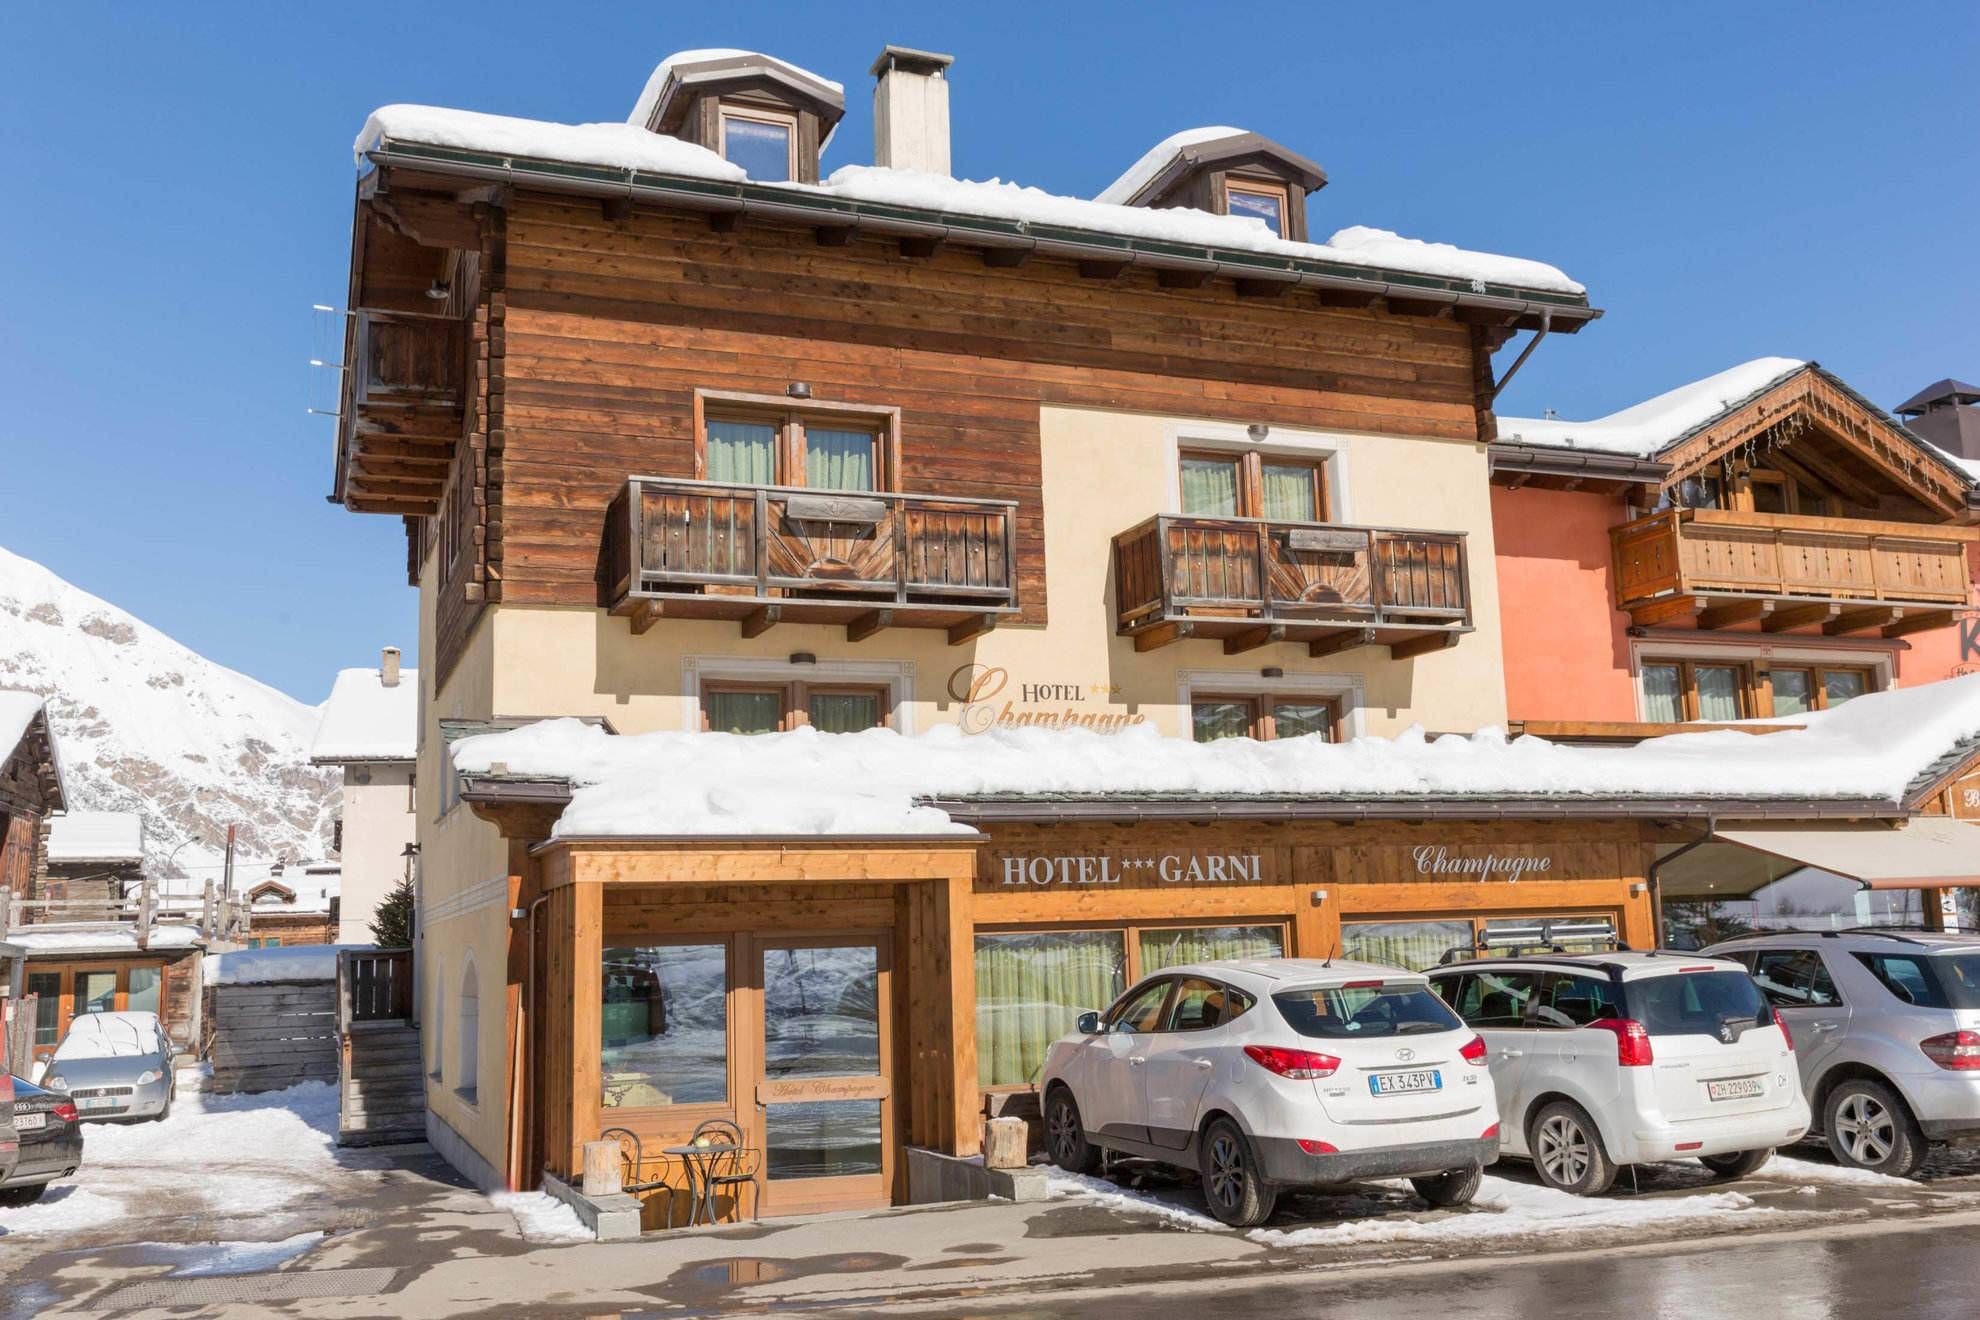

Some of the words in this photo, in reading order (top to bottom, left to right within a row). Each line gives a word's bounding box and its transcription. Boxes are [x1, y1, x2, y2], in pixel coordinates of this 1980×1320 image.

[1022, 683, 1085, 702] HOTEL
[1001, 857, 1120, 885] HOTEL
[1159, 855, 1262, 882] GARNI
[1413, 845, 1551, 883] Champagne
[772, 1083, 804, 1097] Hotel
[812, 1081, 875, 1097] Champagne
